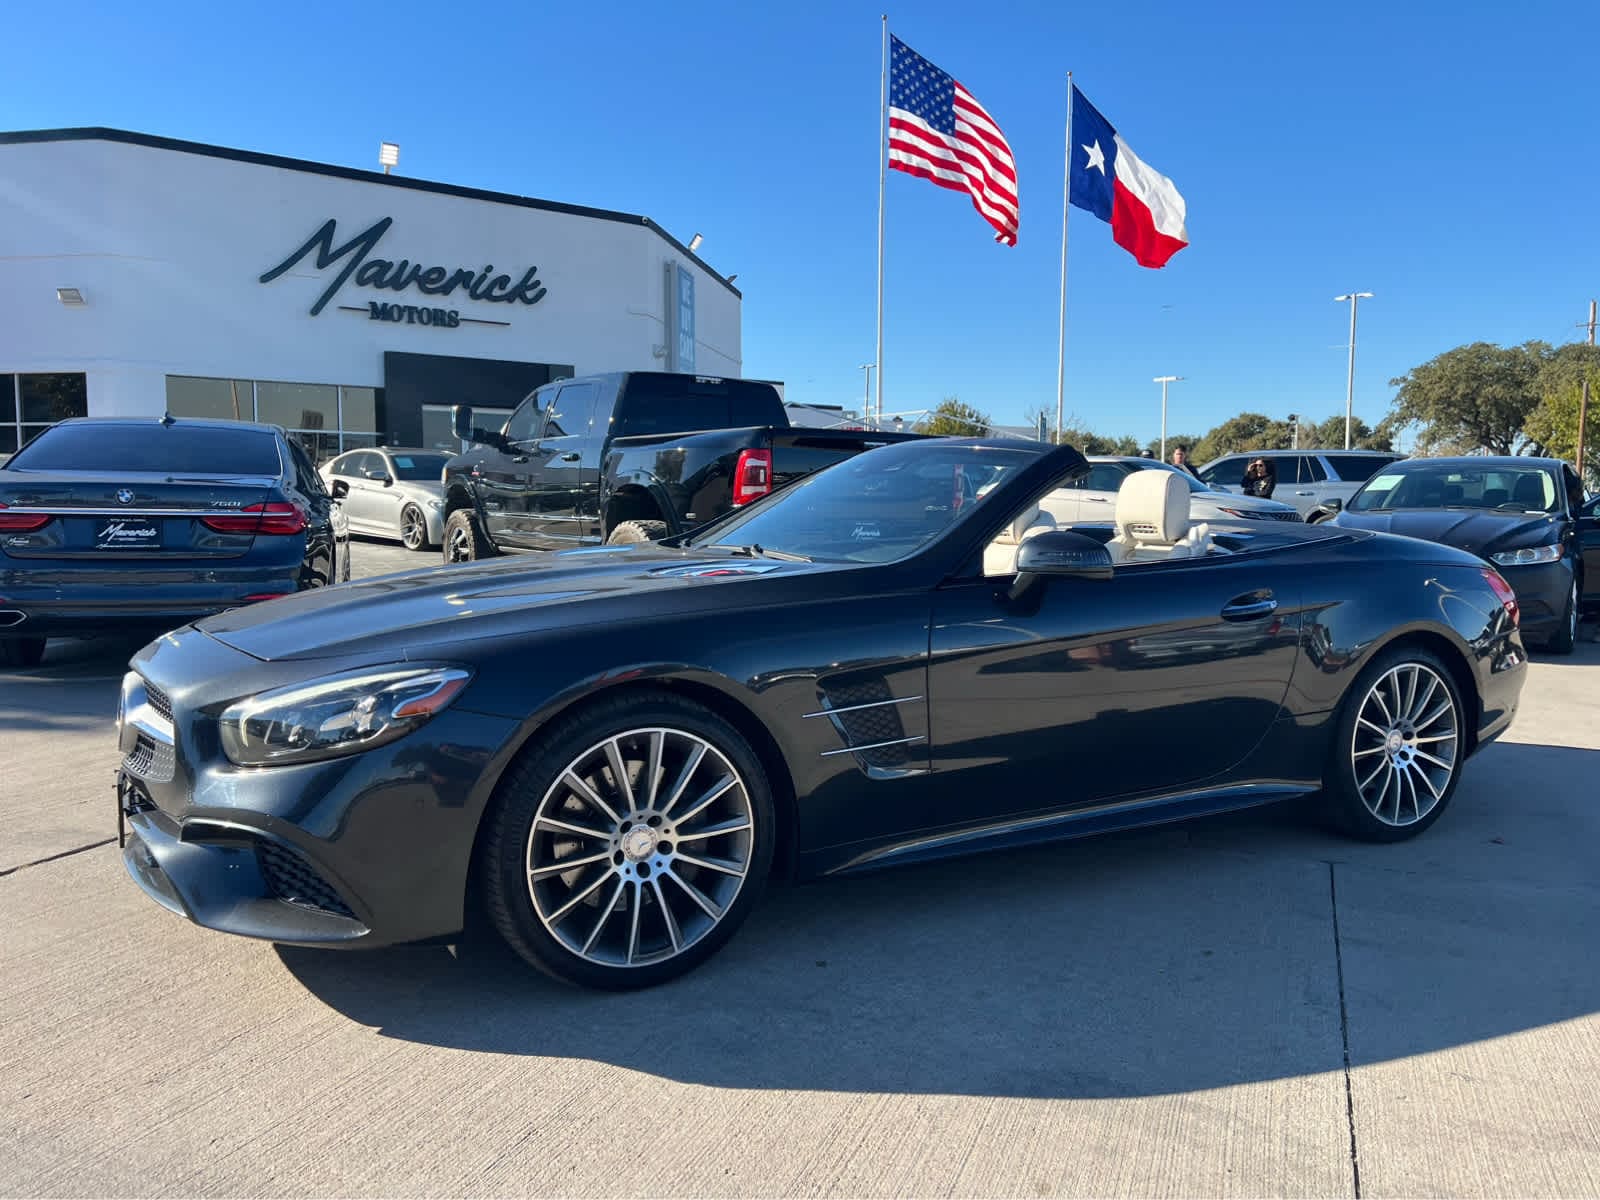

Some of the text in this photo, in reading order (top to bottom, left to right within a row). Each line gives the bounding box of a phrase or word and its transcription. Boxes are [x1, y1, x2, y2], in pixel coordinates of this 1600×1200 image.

[259, 216, 548, 316] Maverick
[368, 301, 460, 328] MOTORS
[98, 522, 157, 541] Maverick
